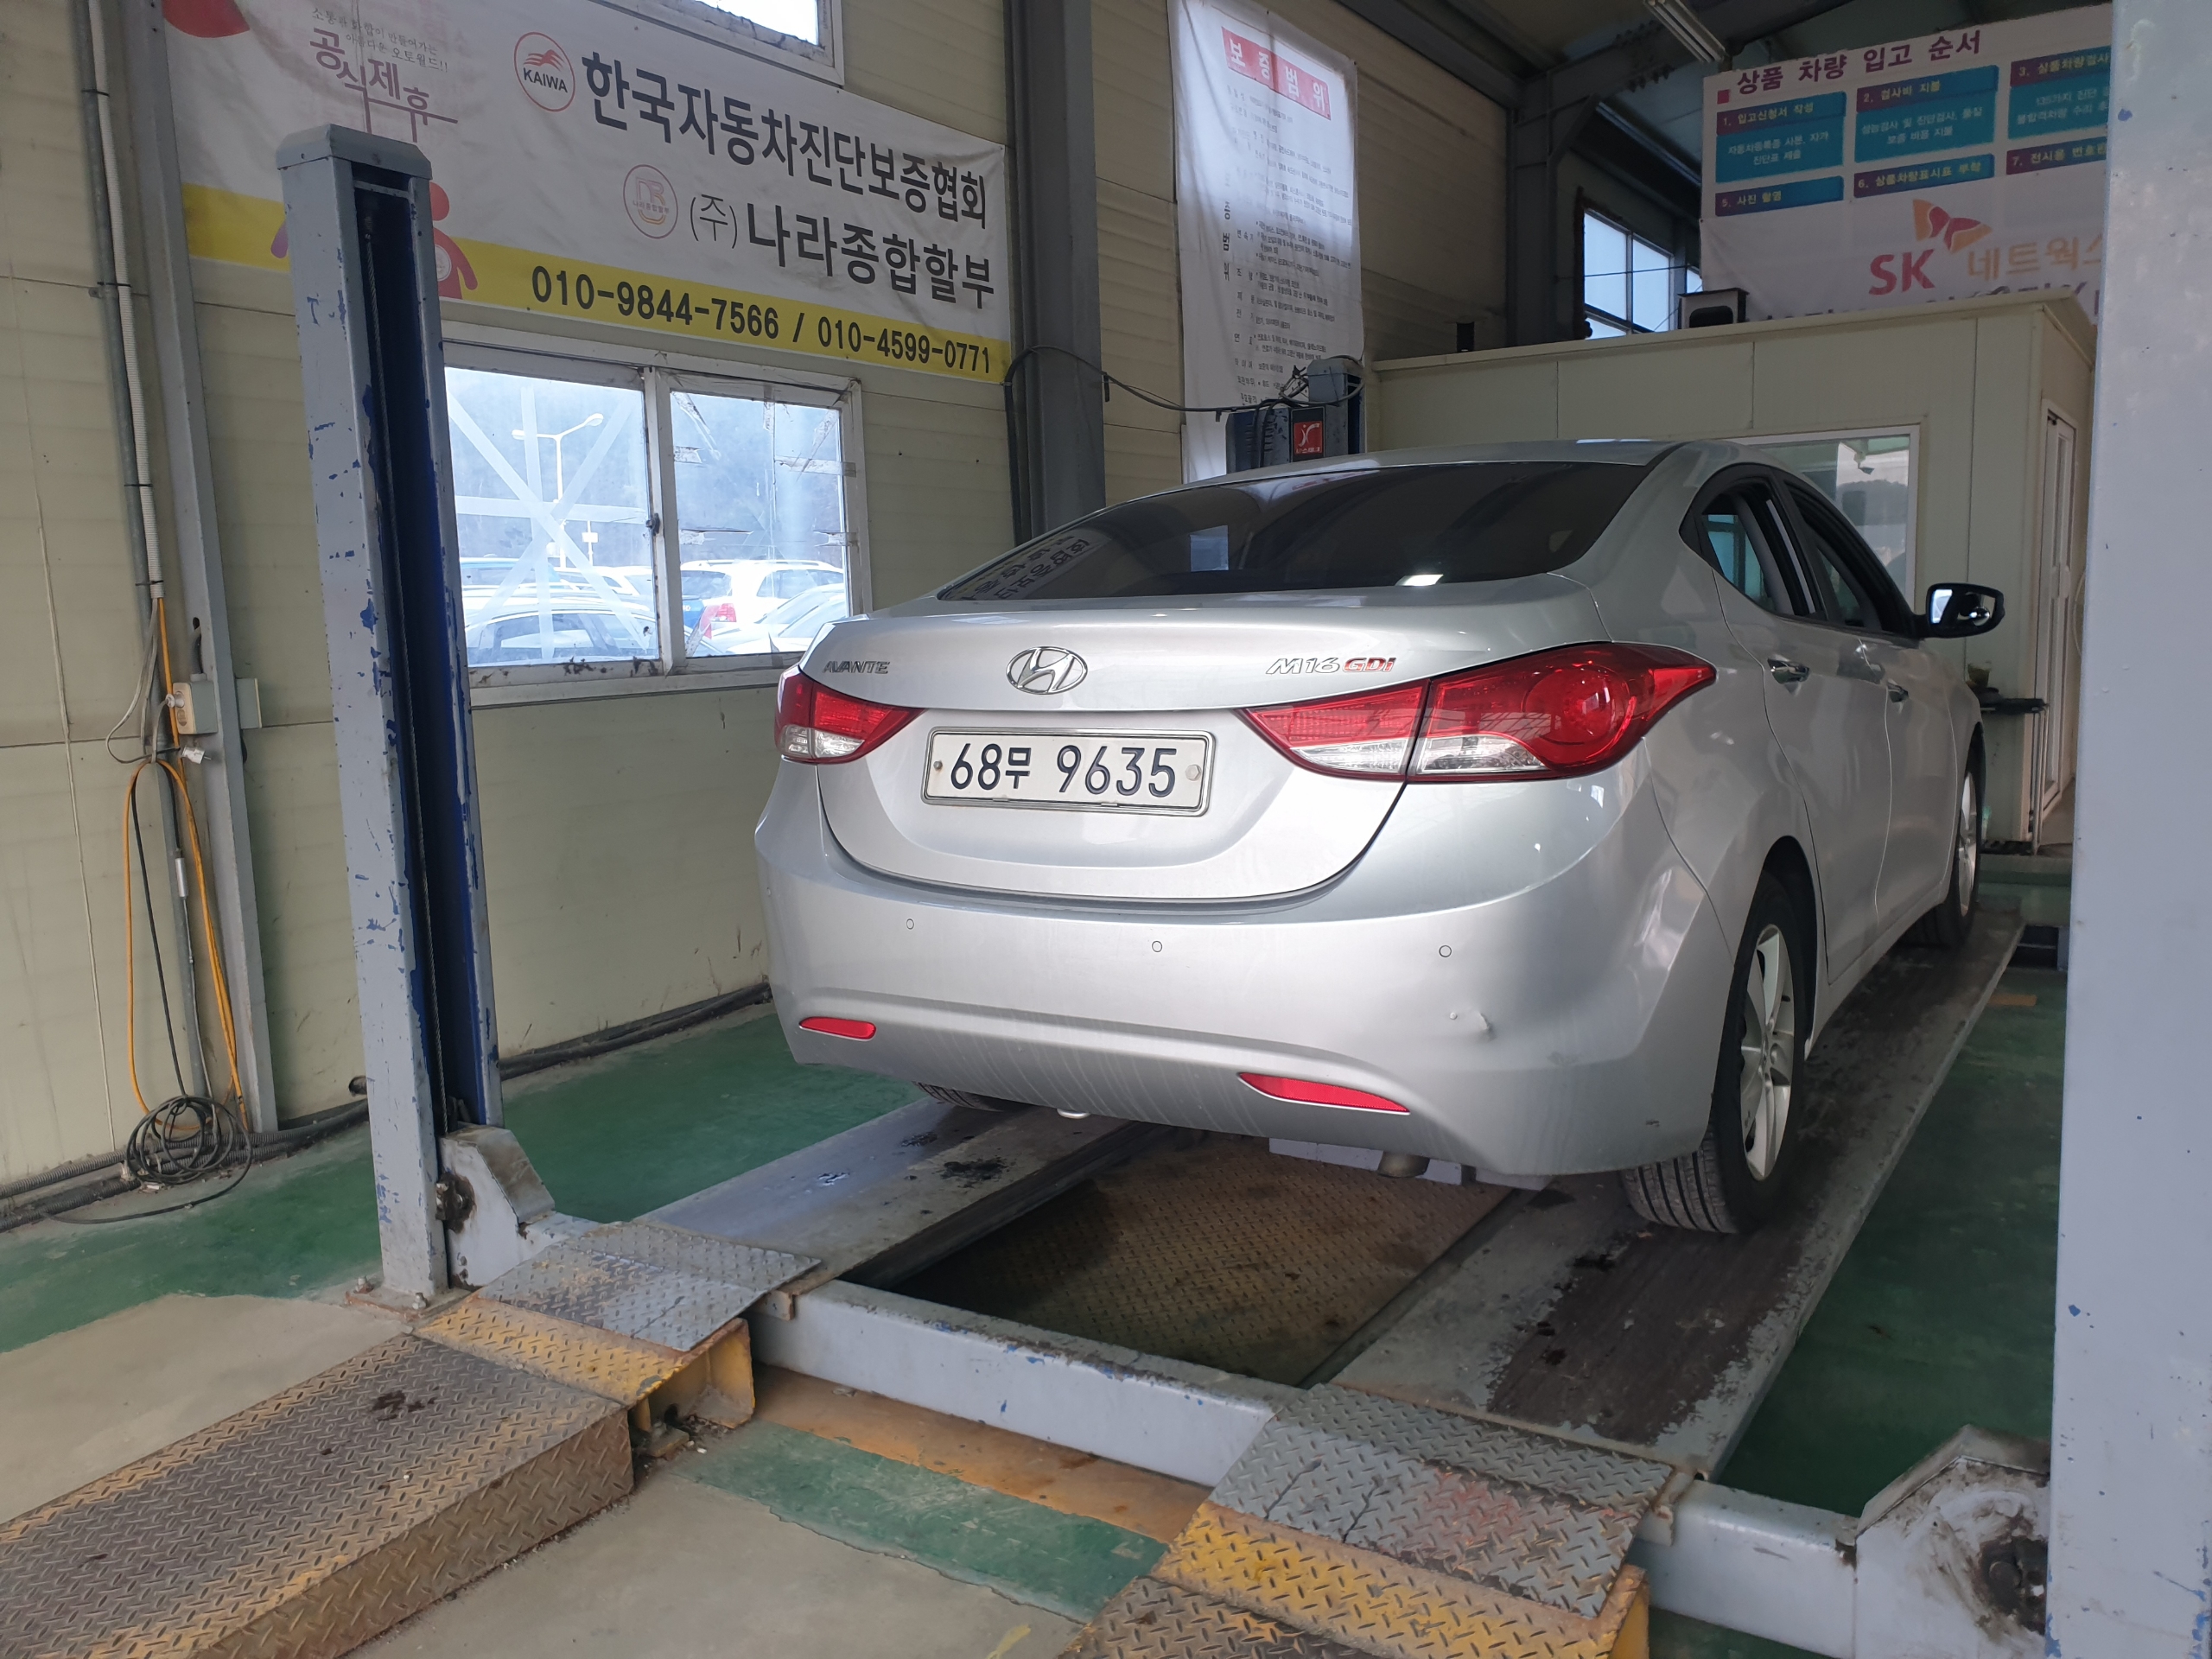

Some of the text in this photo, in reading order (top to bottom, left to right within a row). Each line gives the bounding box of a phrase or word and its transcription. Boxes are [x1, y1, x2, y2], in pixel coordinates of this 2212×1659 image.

[389, 33, 438, 56] 만들어가는
[392, 48, 448, 73] 오토월드!!
[1737, 29, 1980, 95] 상품 차량 입고 순서
[523, 68, 569, 93] KAIWA
[582, 52, 986, 229] 한국자동차진단보증협회
[1869, 249, 1936, 296] SK
[532, 266, 779, 339] 010-9844-7566
[817, 316, 990, 374] 010-4599-0771
[822, 660, 890, 674] AVANTE
[950, 743, 1178, 798] 68무 9635
